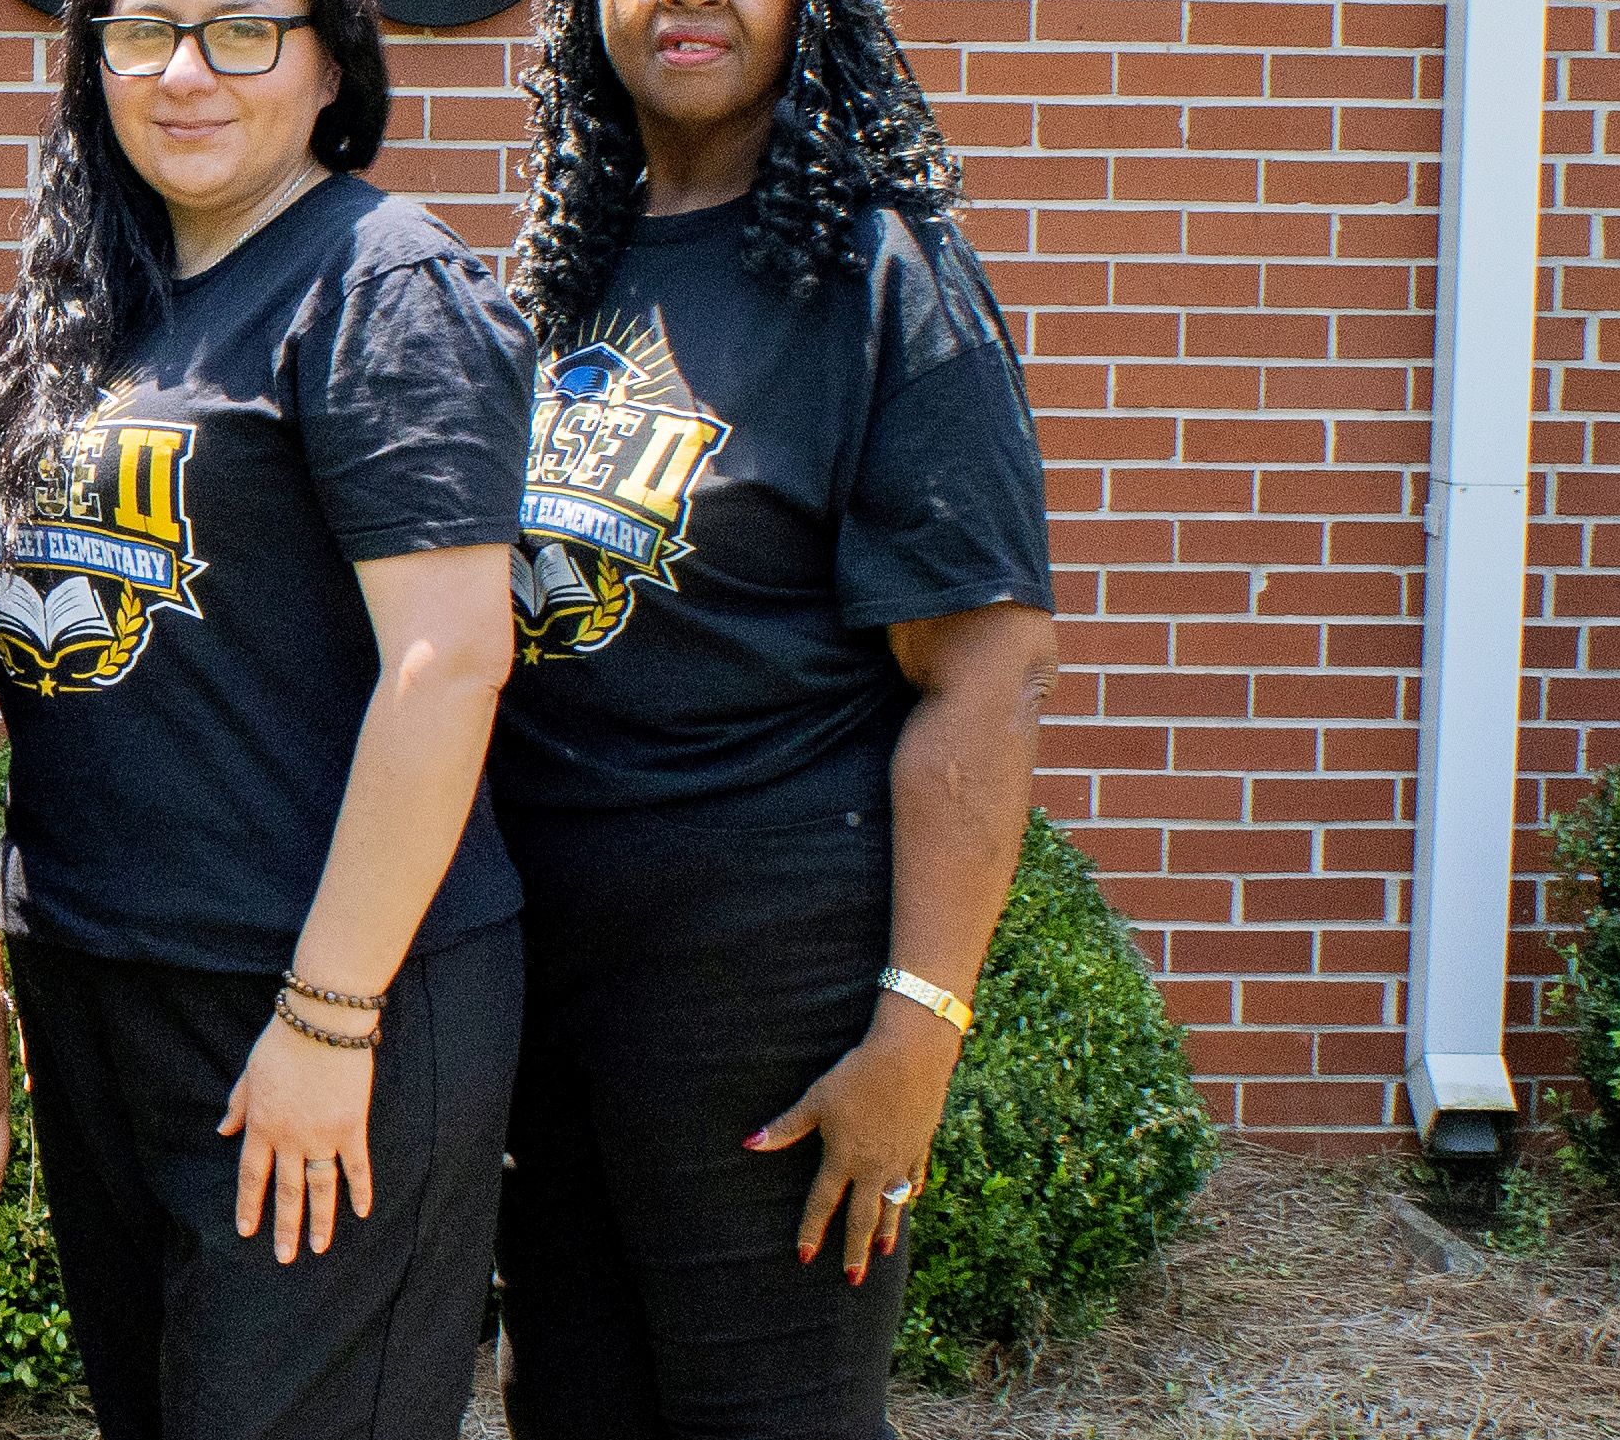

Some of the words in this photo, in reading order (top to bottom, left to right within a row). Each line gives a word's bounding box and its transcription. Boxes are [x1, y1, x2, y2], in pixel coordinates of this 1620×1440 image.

[114, 427, 184, 544] II
[47, 530, 167, 582] ELEMENTARY
[535, 494, 650, 558] ELEMENTARY
